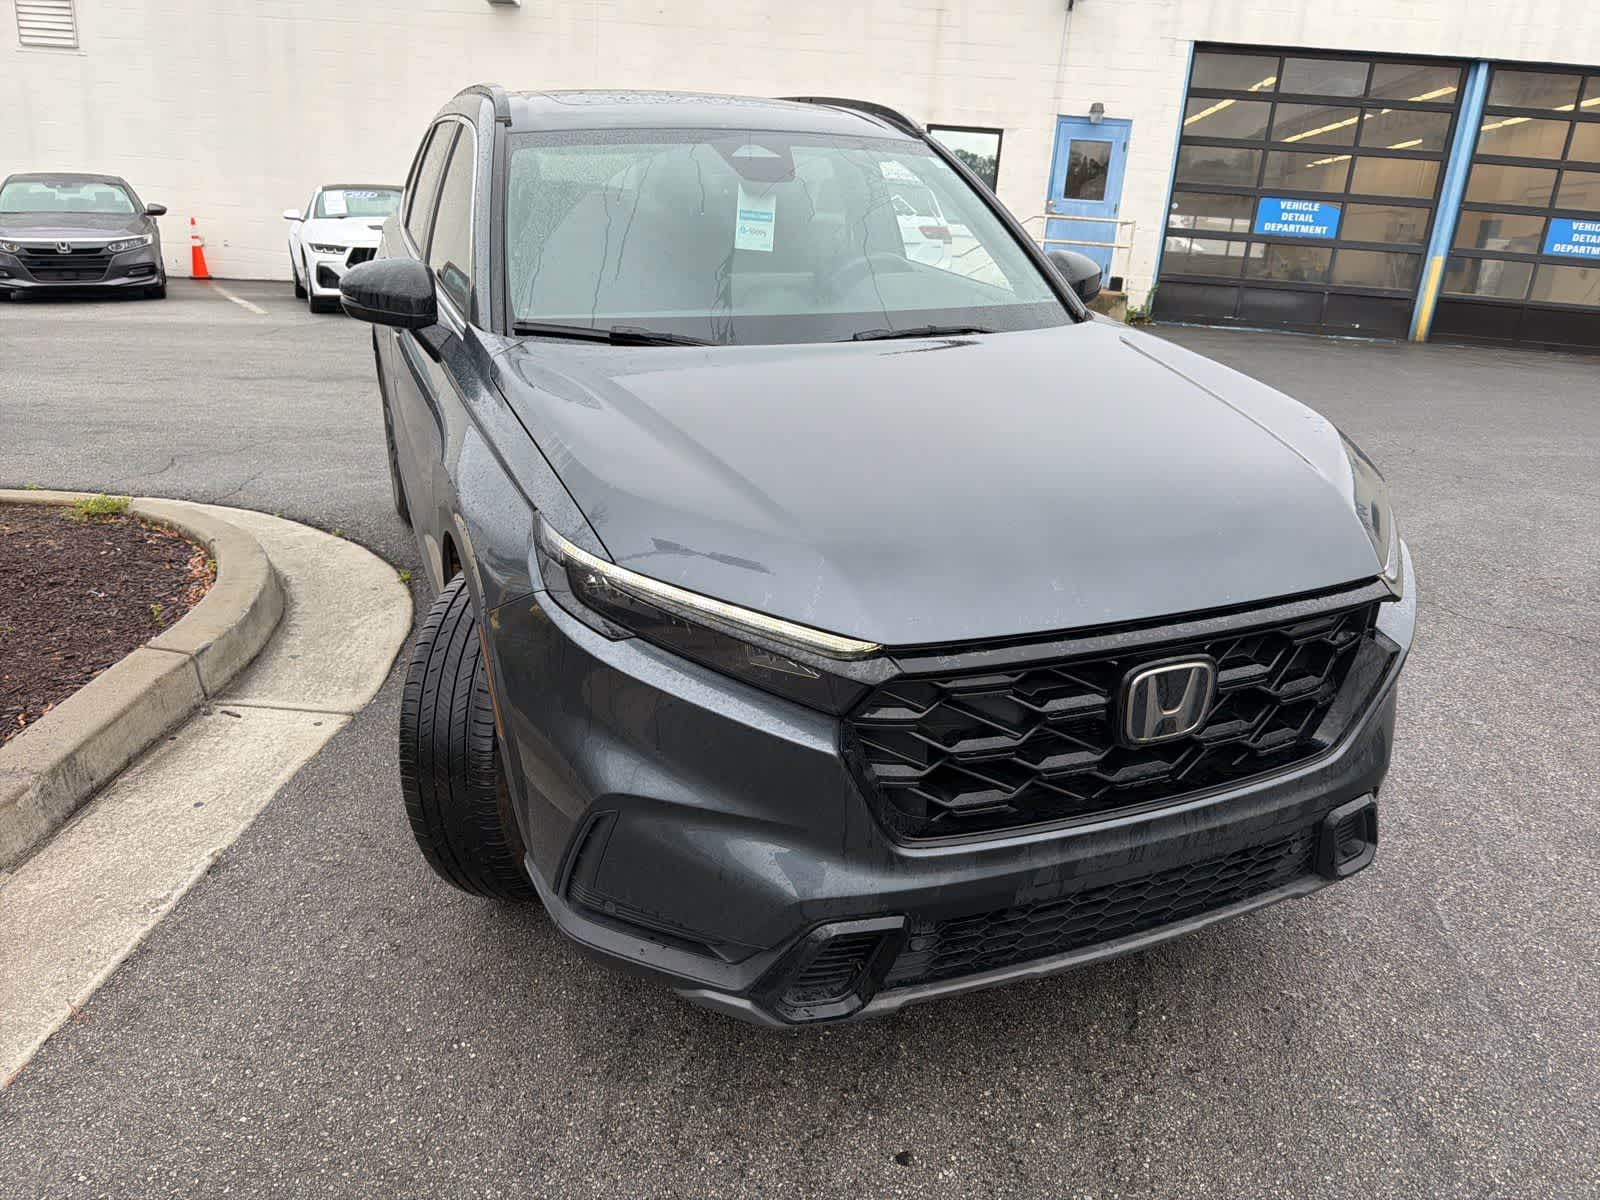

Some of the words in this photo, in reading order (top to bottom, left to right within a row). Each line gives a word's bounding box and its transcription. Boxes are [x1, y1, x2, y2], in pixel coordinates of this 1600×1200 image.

[1280, 201, 1321, 212] VEHICLE
[1281, 212, 1314, 223] DETAIL
[1264, 222, 1329, 235] DEPARTMENT
